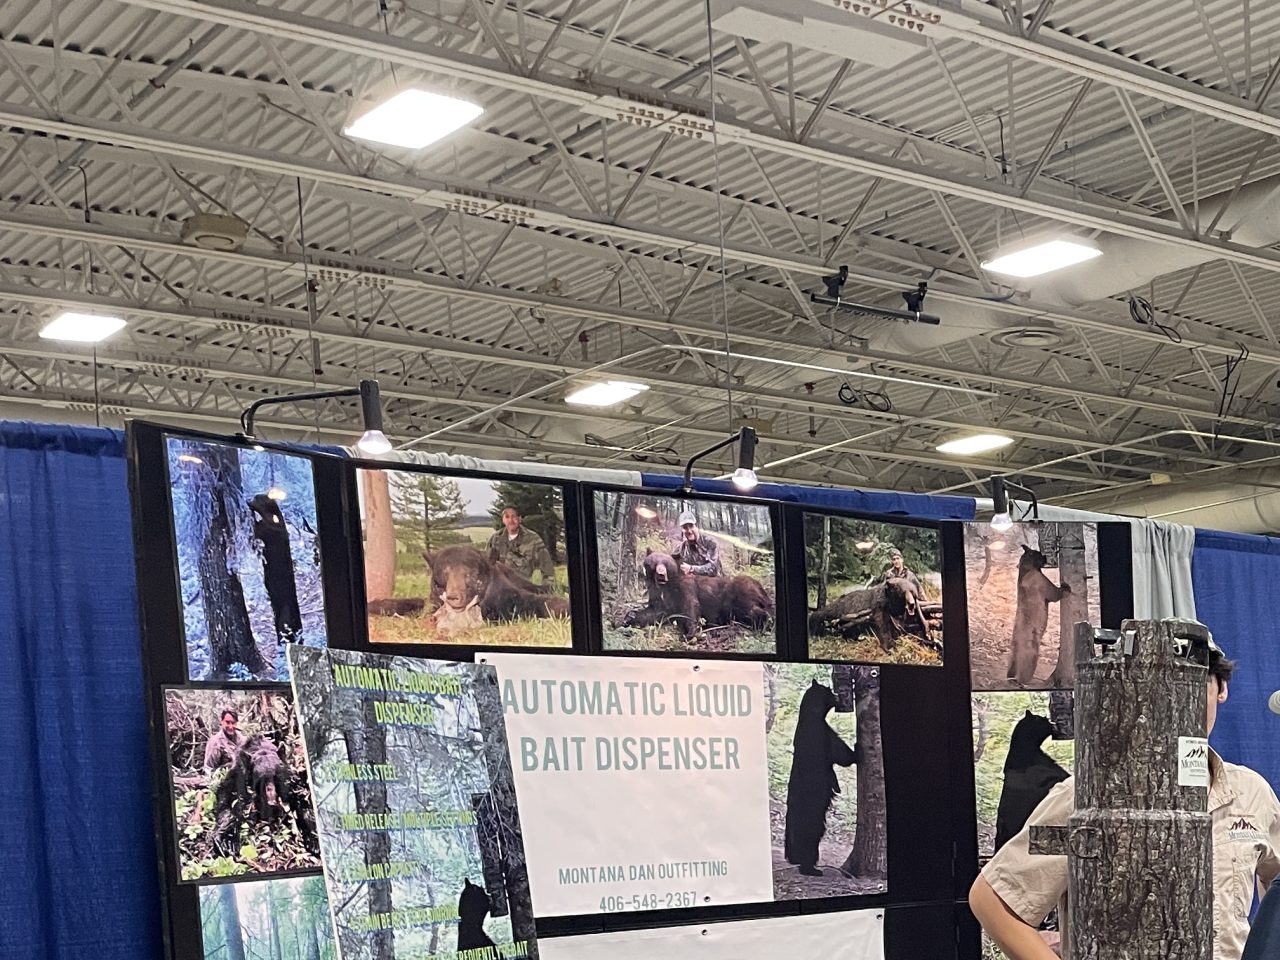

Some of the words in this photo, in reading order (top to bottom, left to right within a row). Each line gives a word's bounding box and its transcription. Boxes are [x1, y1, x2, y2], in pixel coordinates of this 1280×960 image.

[333, 664, 400, 692] AUTOMATIC
[503, 679, 666, 716] AUTOMATIC
[673, 682, 752, 718] LIQUID
[373, 701, 433, 726] DISPENSER
[520, 736, 586, 771] BAIT
[595, 737, 740, 771] DISPENSER
[373, 764, 399, 781] STEEL
[559, 866, 625, 885] MONTANA
[629, 864, 655, 881] DAN
[658, 860, 728, 879] OUTFITTING
[599, 890, 697, 912] 406-548-2367
